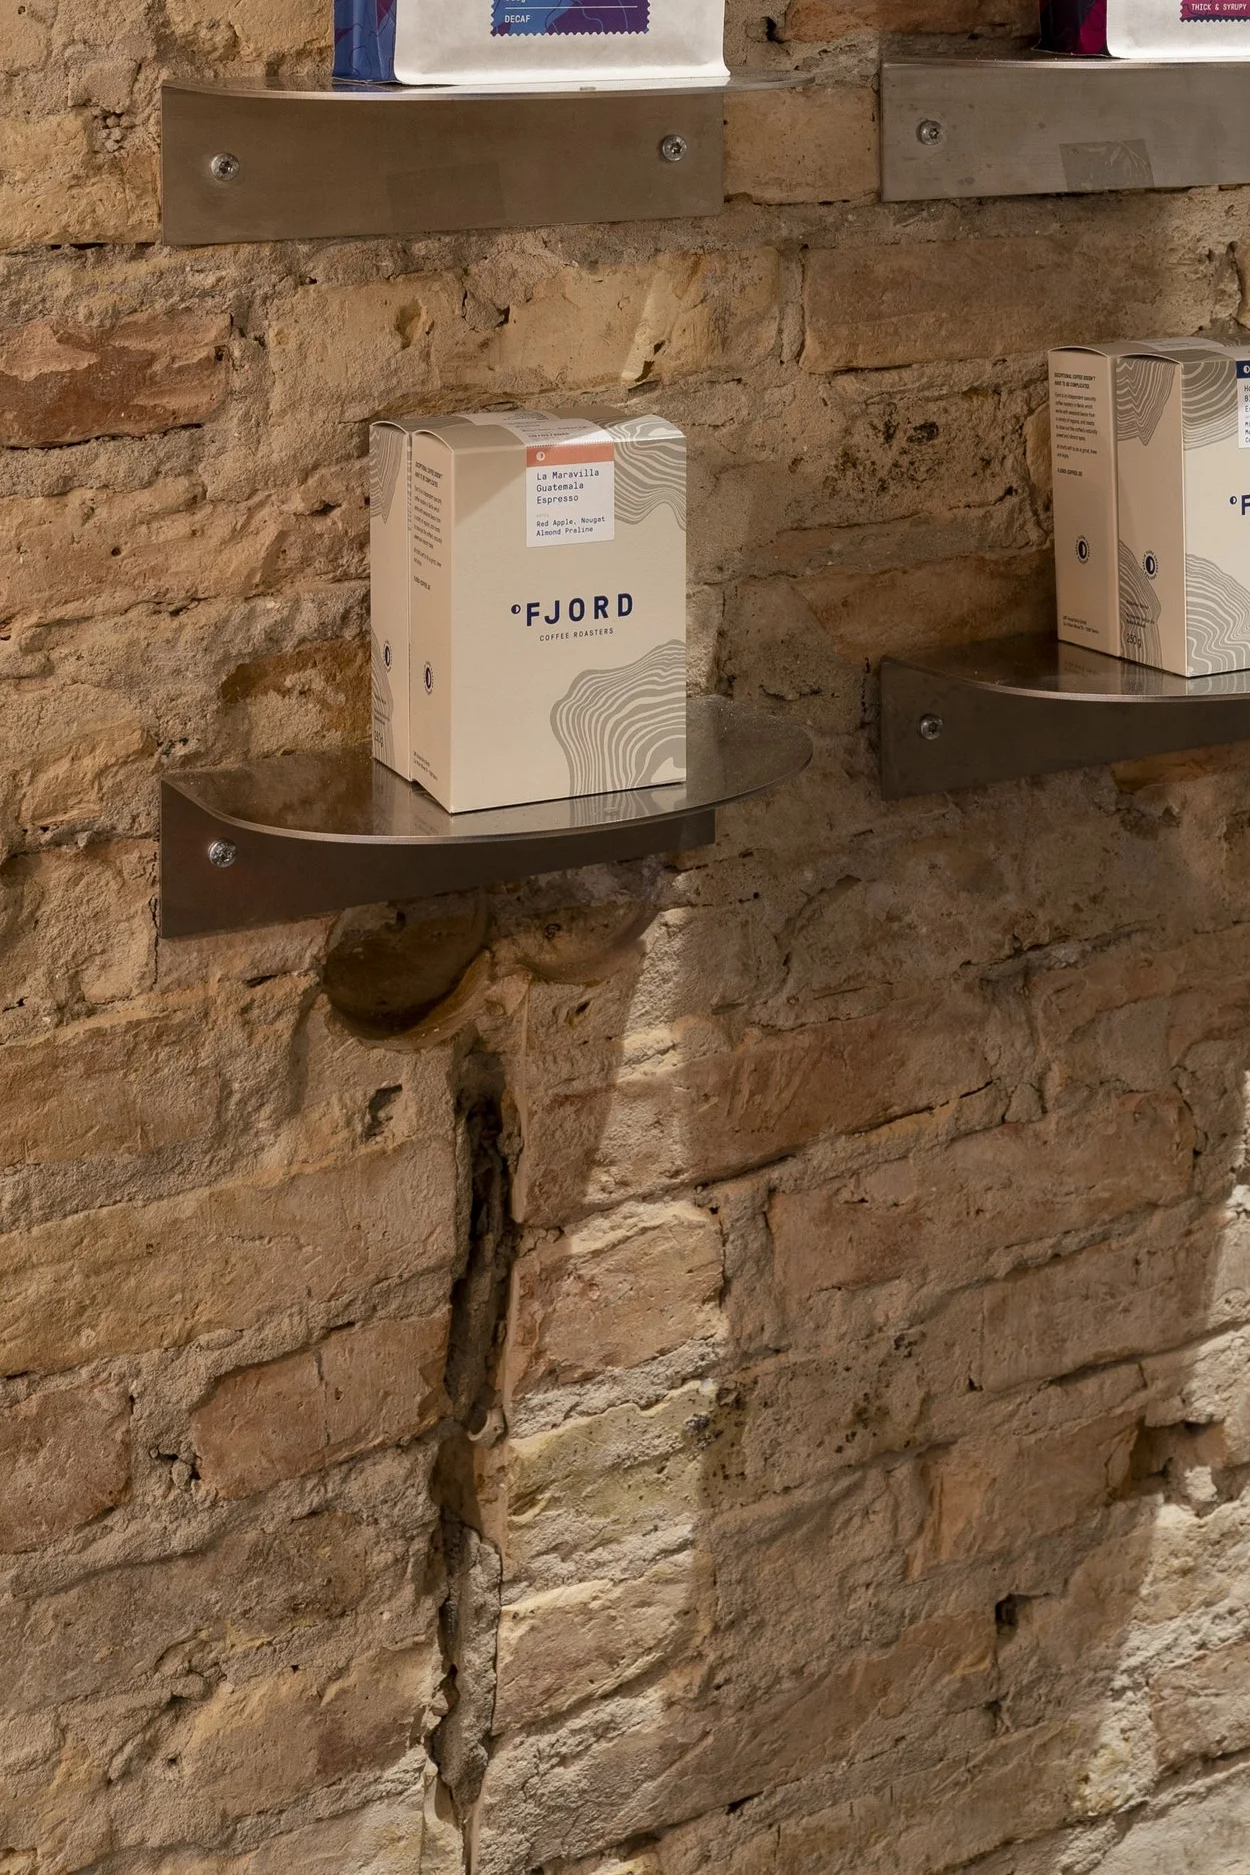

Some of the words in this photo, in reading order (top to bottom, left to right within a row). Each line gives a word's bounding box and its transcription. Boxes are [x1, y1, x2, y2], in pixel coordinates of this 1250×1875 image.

[505, 15, 530, 23] DECAF
[552, 469, 599, 479] Maravilla
[537, 482, 584, 492] Guatemala
[537, 495, 579, 505] Espresso
[526, 593, 632, 627] FJORD
[540, 633, 569, 641] COFFEE
[574, 628, 614, 638] ROASTERS
